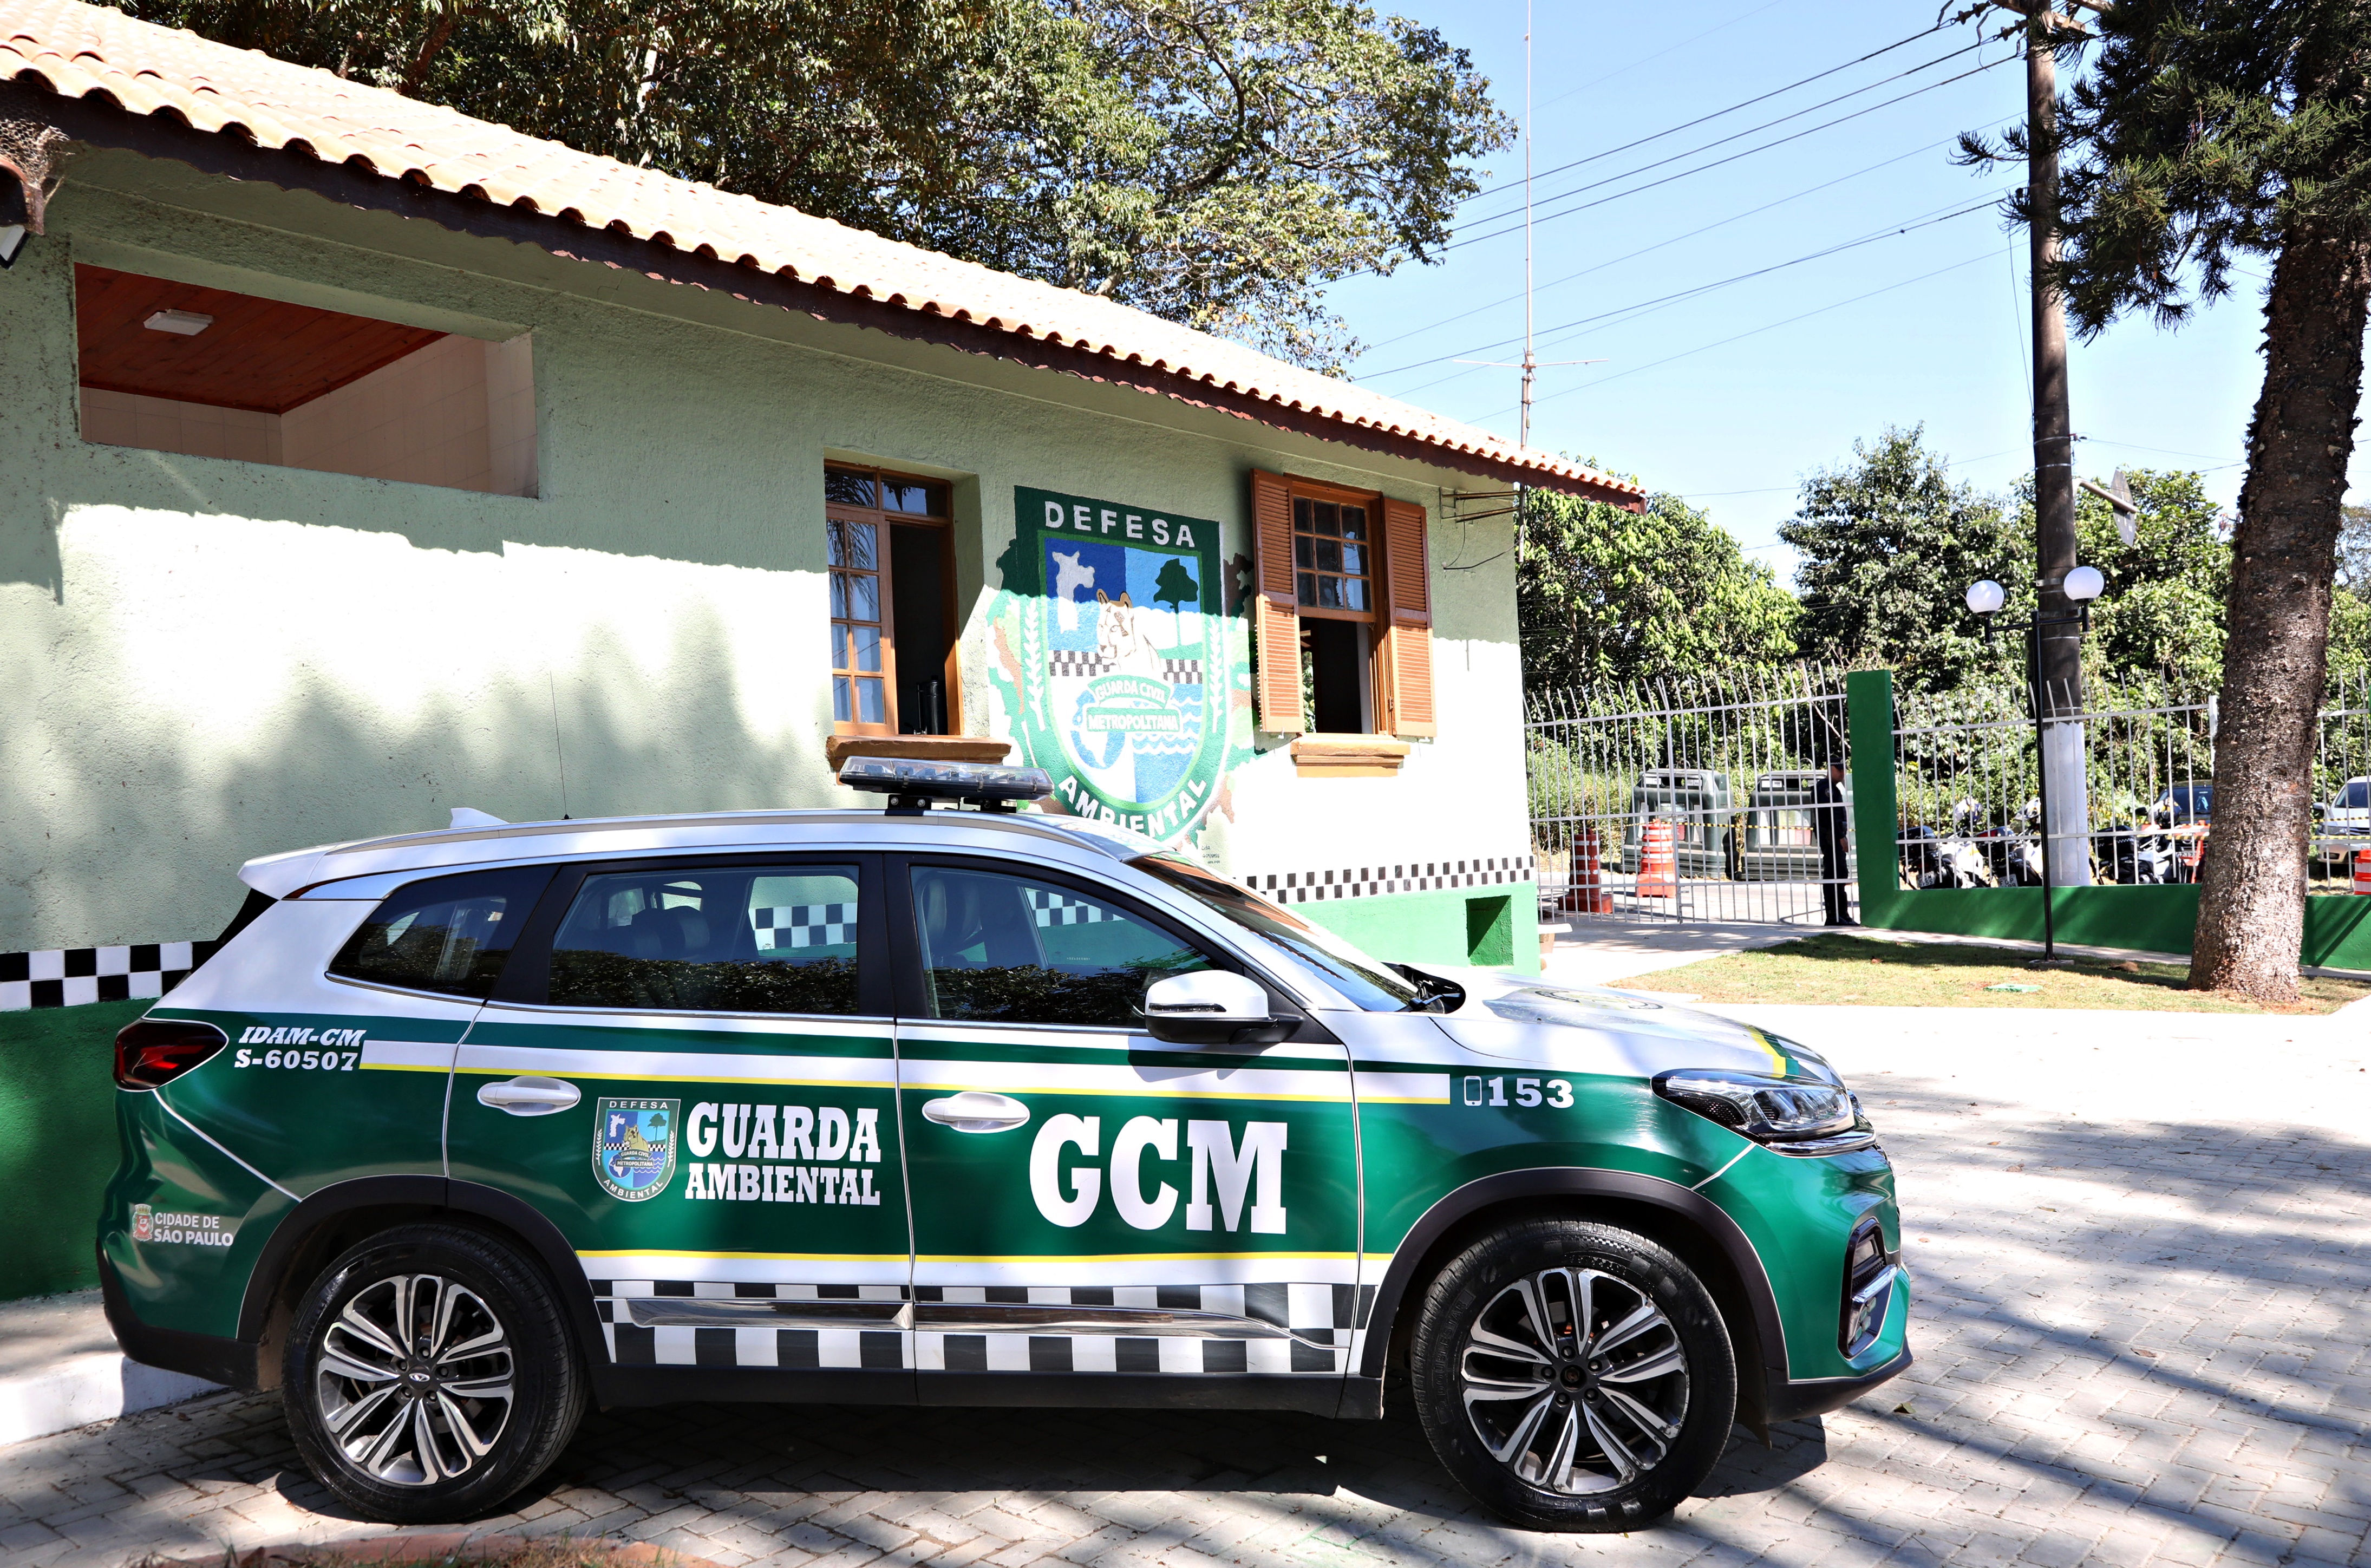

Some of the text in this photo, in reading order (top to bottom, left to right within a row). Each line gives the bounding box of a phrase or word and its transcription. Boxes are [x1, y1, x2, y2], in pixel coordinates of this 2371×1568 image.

[1045, 501, 1195, 547] DEFESA
[1095, 680, 1165, 704] GUARDA CIVIL
[1088, 714, 1178, 730] METROPOLITANA
[238, 1026, 367, 1047] IDAM-CM
[234, 1049, 358, 1071] S-60507
[1488, 1076, 1575, 1108] 153
[609, 1101, 668, 1109] DEFESA
[686, 1102, 881, 1162] GUARDA
[685, 1163, 880, 1205] AMBIENTAL
[1029, 1113, 1288, 1235] GCM
[604, 1179, 663, 1198] AMBIENTAL
[155, 1212, 219, 1229] CIDADE DE
[154, 1226, 233, 1247] SÃO PAULO
